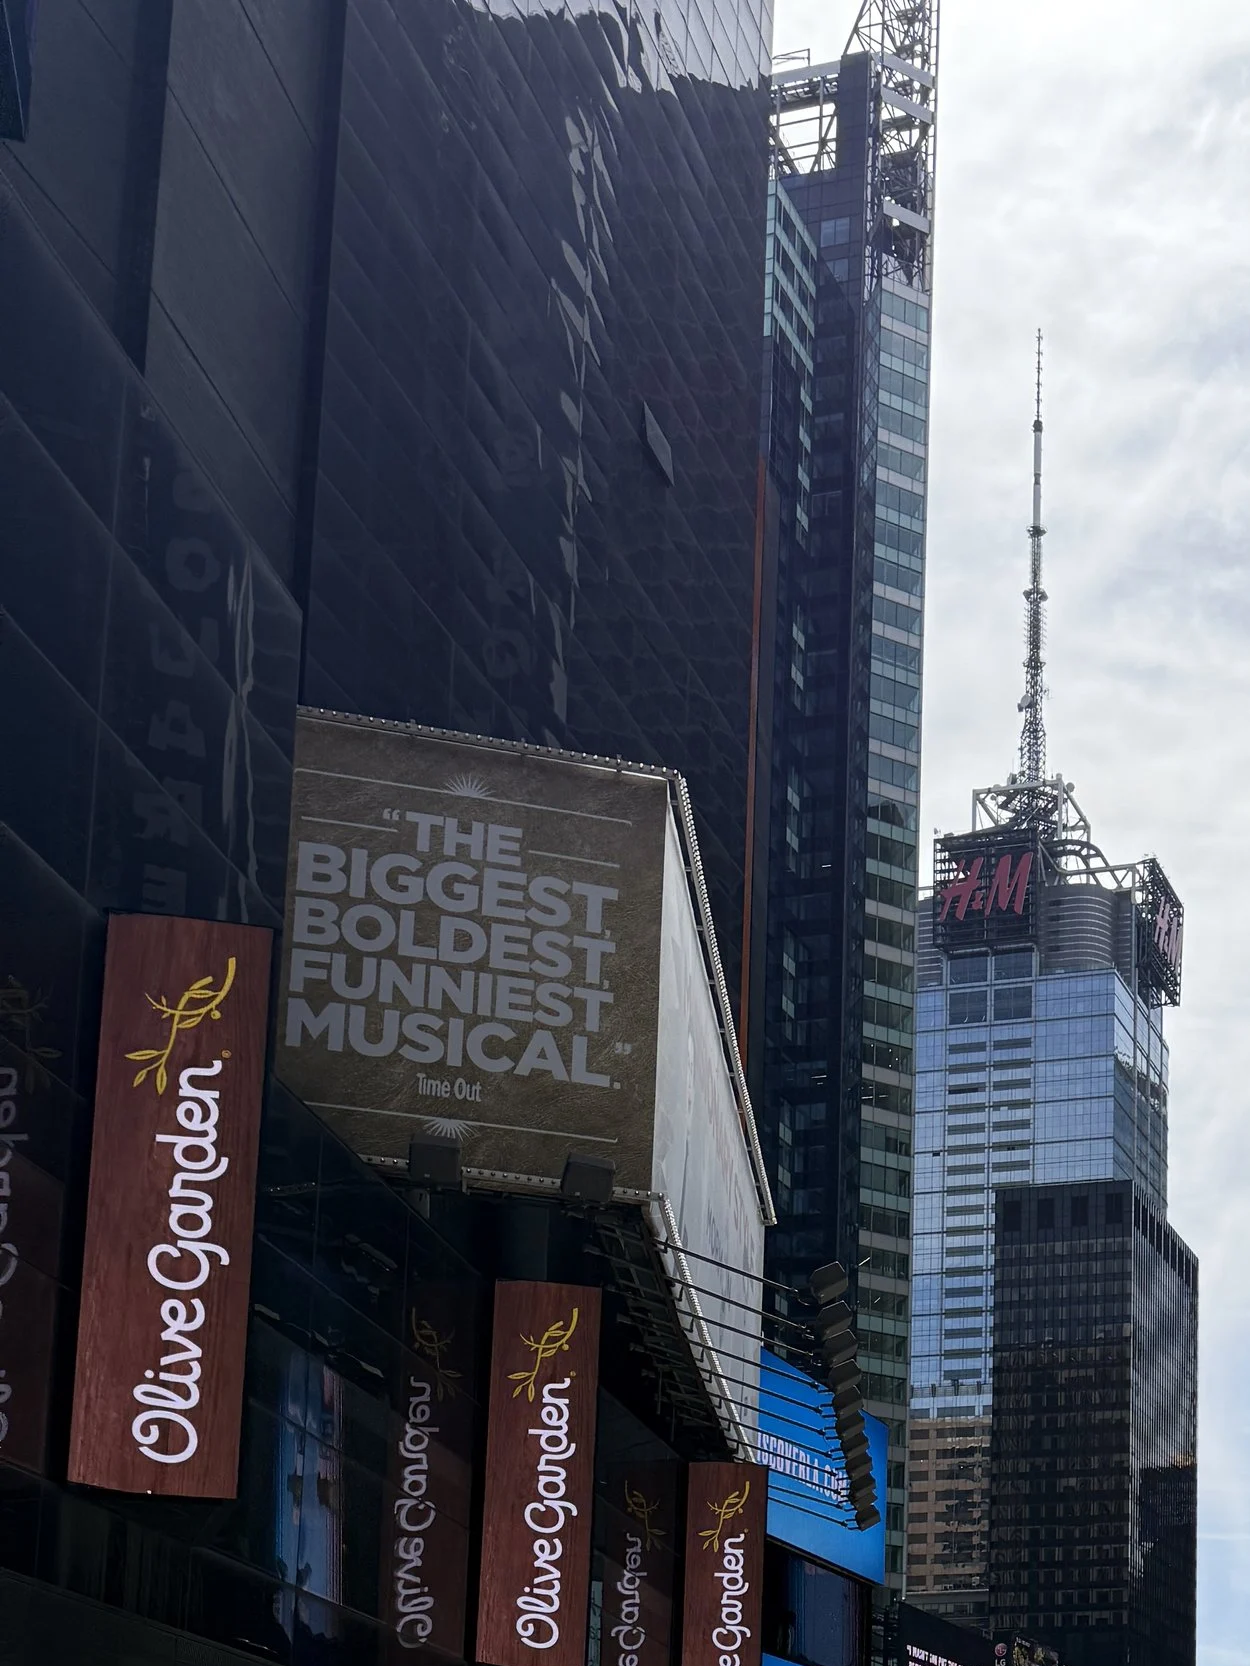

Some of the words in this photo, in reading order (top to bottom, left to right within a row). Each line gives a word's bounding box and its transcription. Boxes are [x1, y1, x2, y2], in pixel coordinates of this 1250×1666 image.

[300, 841, 620, 938] BIGGEST,
[940, 851, 1034, 922] H&M
[289, 950, 615, 1033] FUNNIEST
[292, 897, 617, 990] BOLDEST,
[416, 1072, 450, 1099] Time
[452, 1077, 482, 1102] Out
[147, 1058, 231, 1291] Garden
[131, 1297, 207, 1465] Olive
[525, 1377, 577, 1533] Garden
[517, 1538, 562, 1650] Olive
[711, 1533, 752, 1651] Garden
